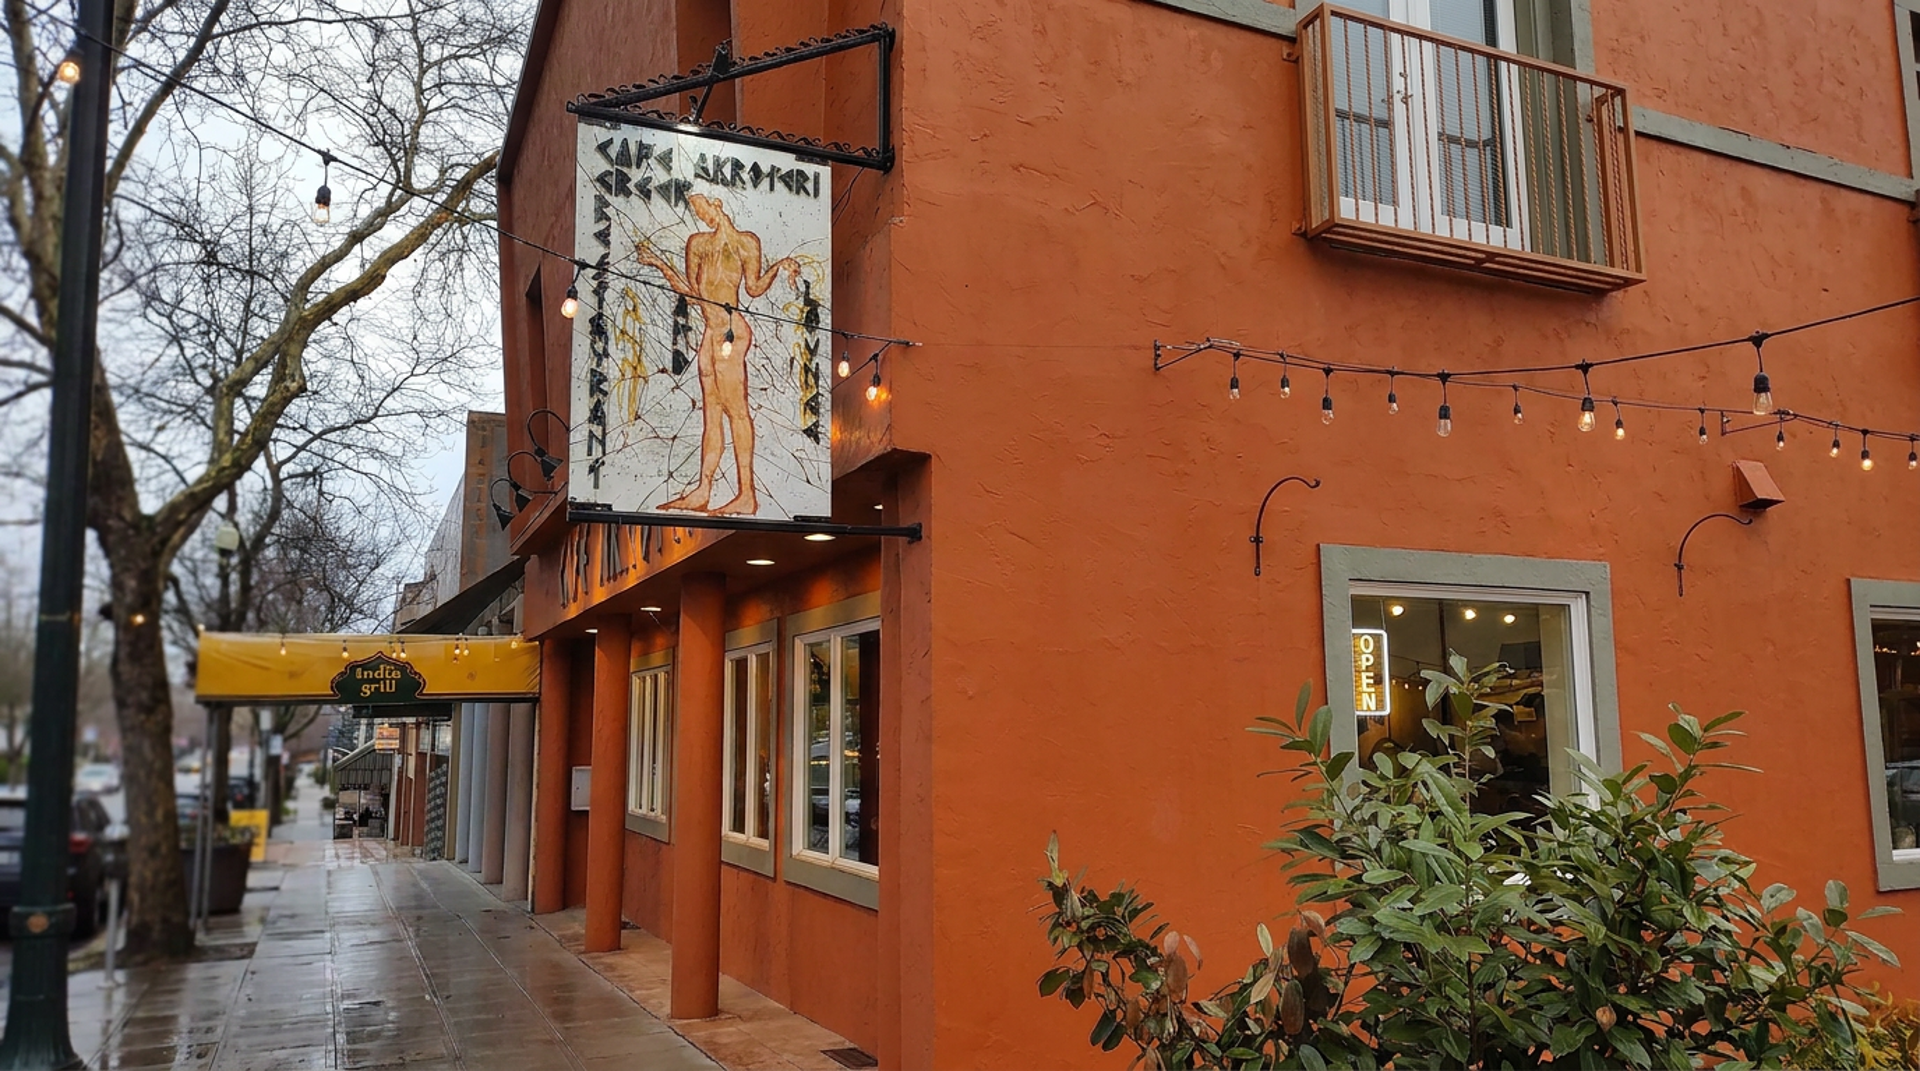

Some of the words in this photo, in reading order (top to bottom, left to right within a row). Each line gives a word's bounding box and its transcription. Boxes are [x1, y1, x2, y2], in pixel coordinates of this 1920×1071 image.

[594, 136, 674, 172] CAFE
[595, 168, 693, 208] GREEK
[587, 194, 611, 490] RESTAURANT
[802, 279, 821, 445] LOUNGE
[1360, 634, 1377, 711] OPEN
